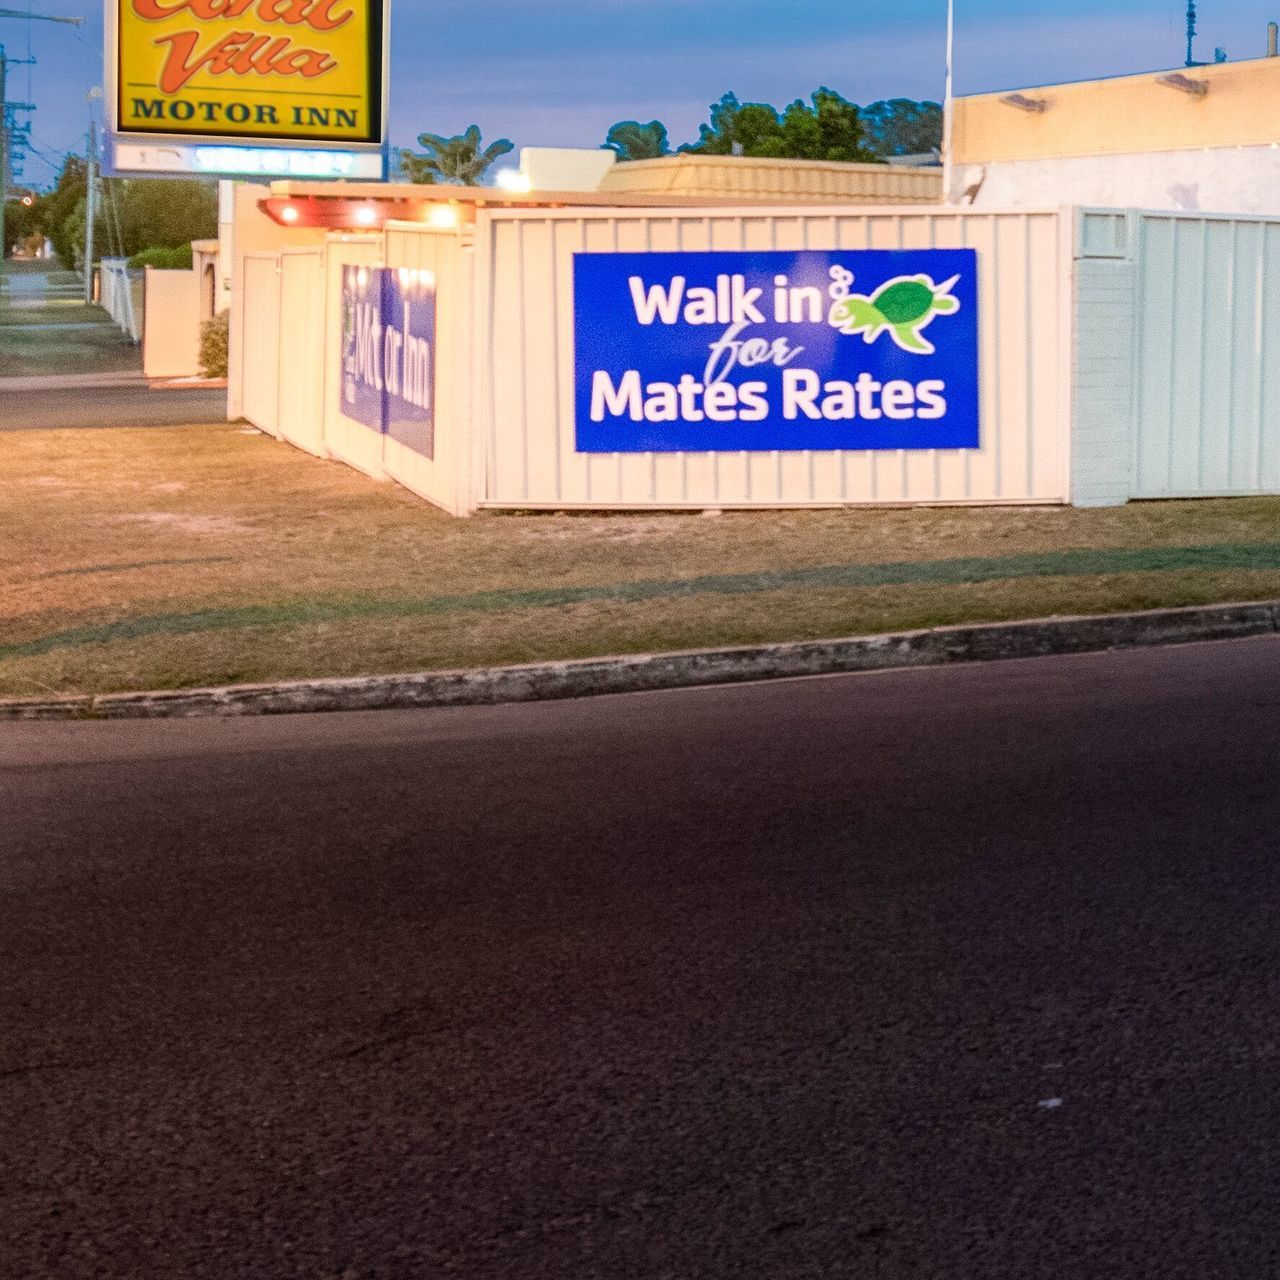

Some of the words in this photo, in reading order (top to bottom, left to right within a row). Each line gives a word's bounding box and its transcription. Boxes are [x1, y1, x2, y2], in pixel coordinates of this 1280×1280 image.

[153, 30, 338, 95] Villa
[131, 98, 279, 125] MOTOR
[291, 106, 358, 128] INN
[628, 274, 766, 325] Walk
[774, 274, 823, 324] in
[703, 319, 804, 388] for
[590, 370, 770, 422] Mates
[782, 368, 947, 420] Rates
